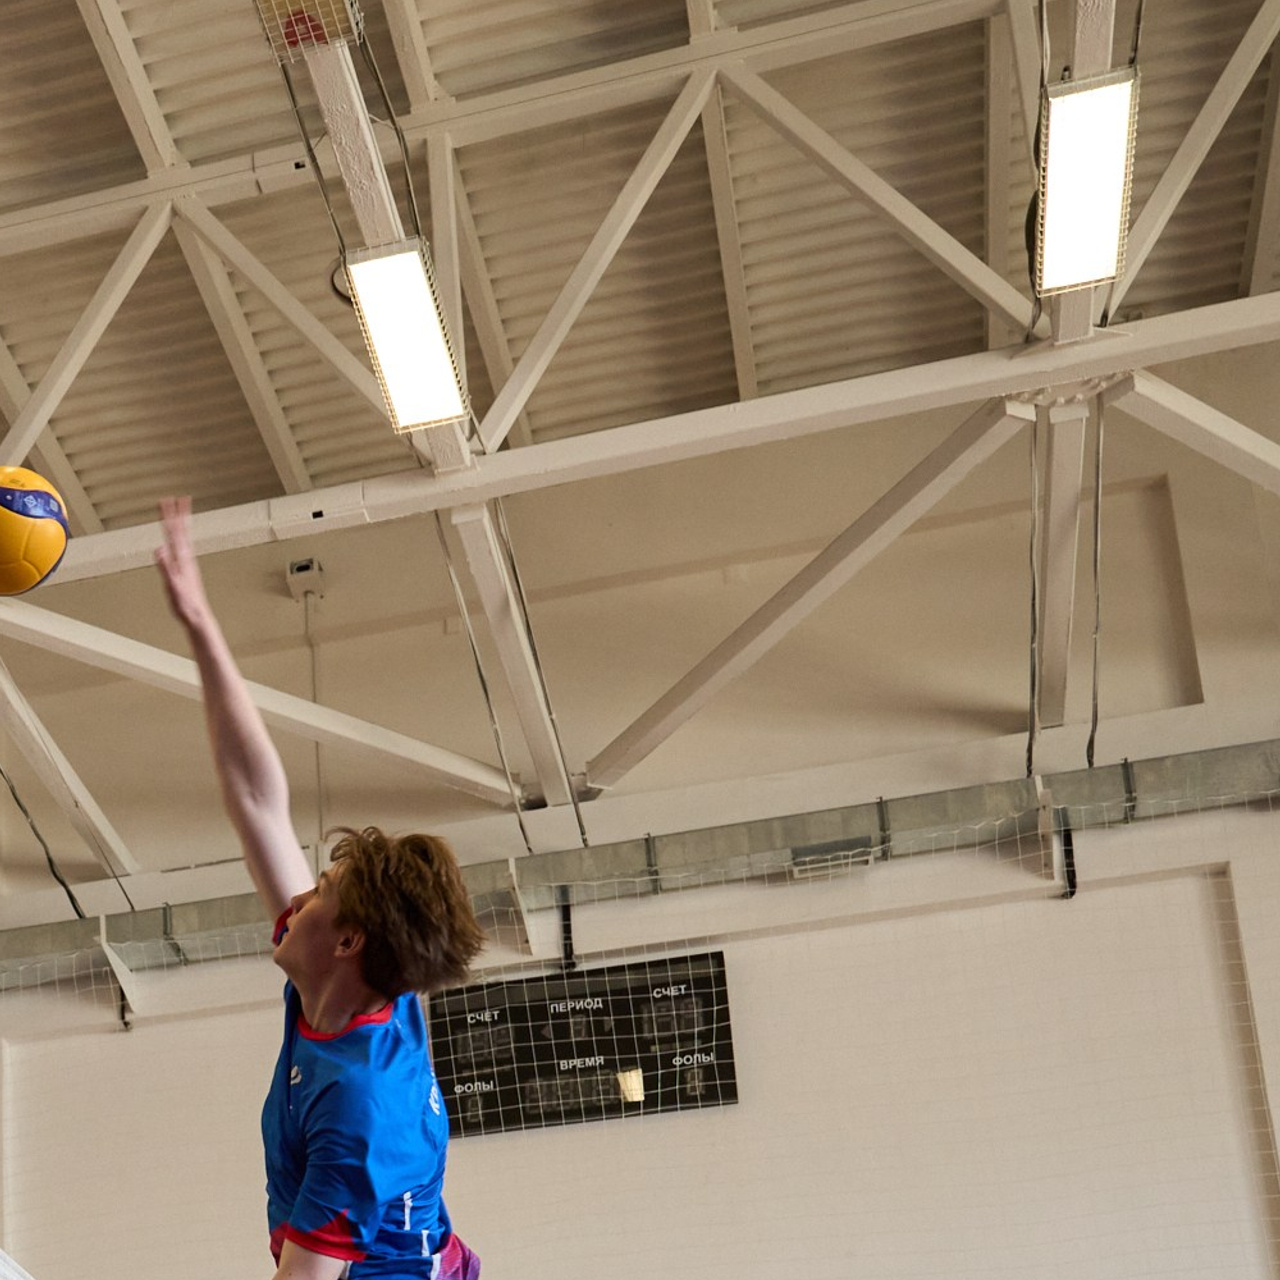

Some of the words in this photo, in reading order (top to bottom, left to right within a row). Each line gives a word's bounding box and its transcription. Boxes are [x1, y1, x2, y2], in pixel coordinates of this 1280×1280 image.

[653, 984, 687, 998] СЧЕТ
[550, 998, 603, 1014] ПЕРИОД
[559, 1056, 605, 1070] ВРЕМЯ
[672, 1052, 714, 1066] ФОЛЫ
[454, 1080, 494, 1094] ФОЛЫ
